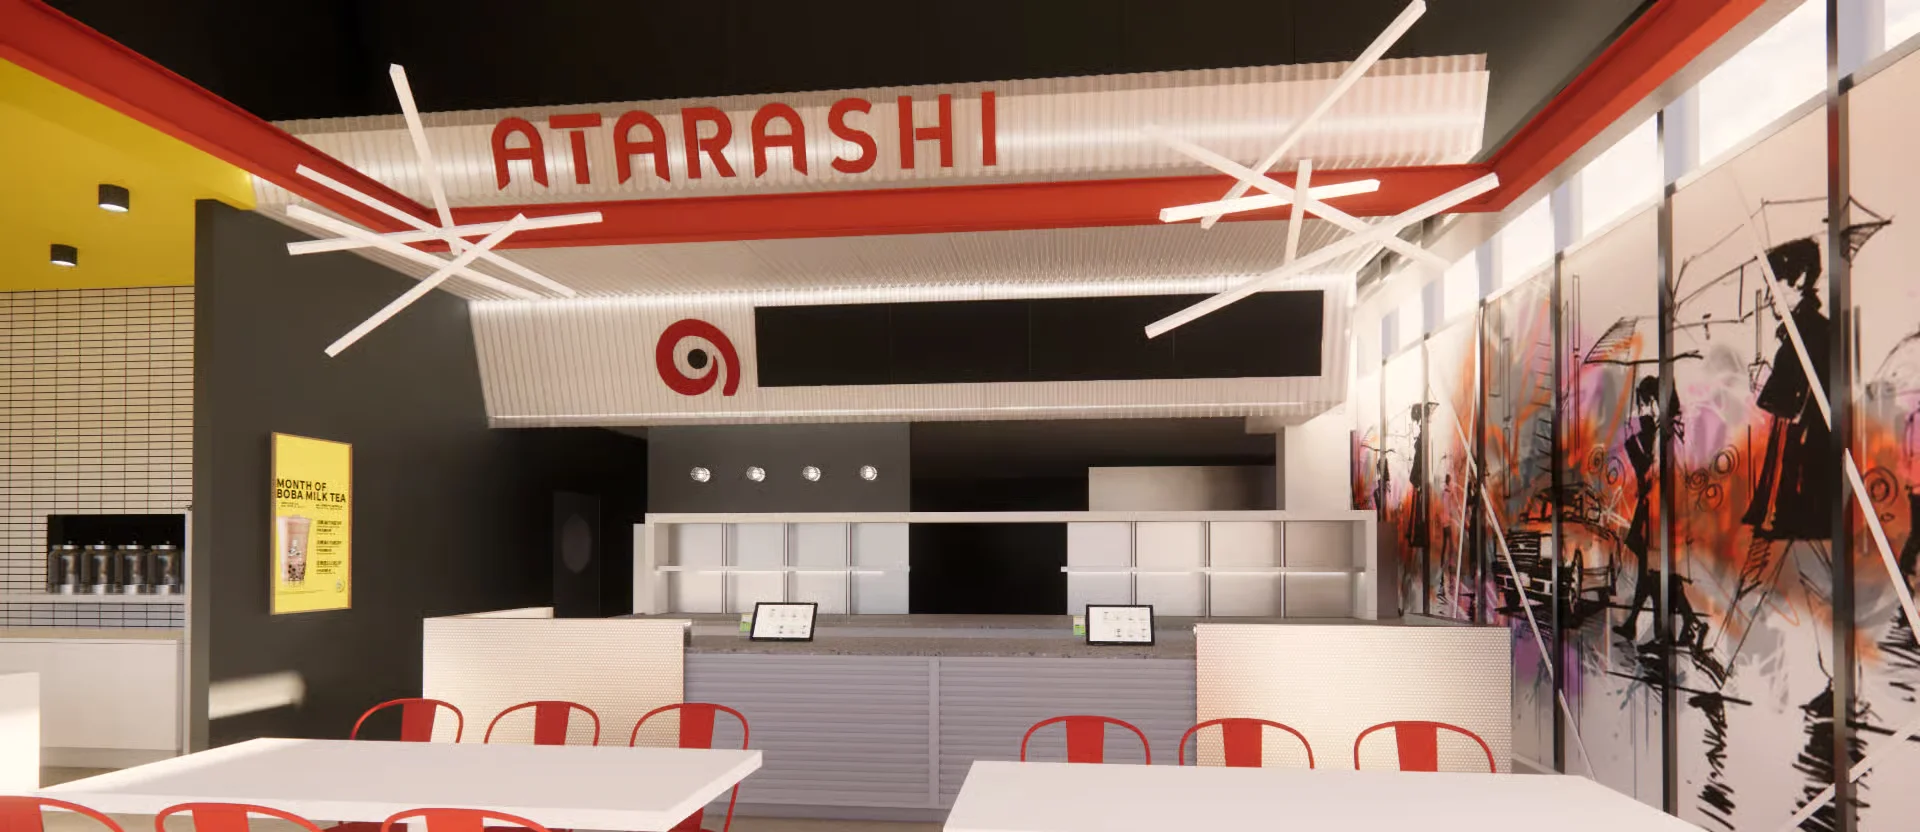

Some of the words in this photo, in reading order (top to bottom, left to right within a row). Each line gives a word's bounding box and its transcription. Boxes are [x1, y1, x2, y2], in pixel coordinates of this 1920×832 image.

[491, 91, 997, 190] ATARASHI
[276, 478, 312, 491] MONTH
[314, 482, 327, 492] OF
[276, 489, 304, 500] BOBA
[305, 491, 328, 502] MILK
[329, 492, 346, 503] TEA
